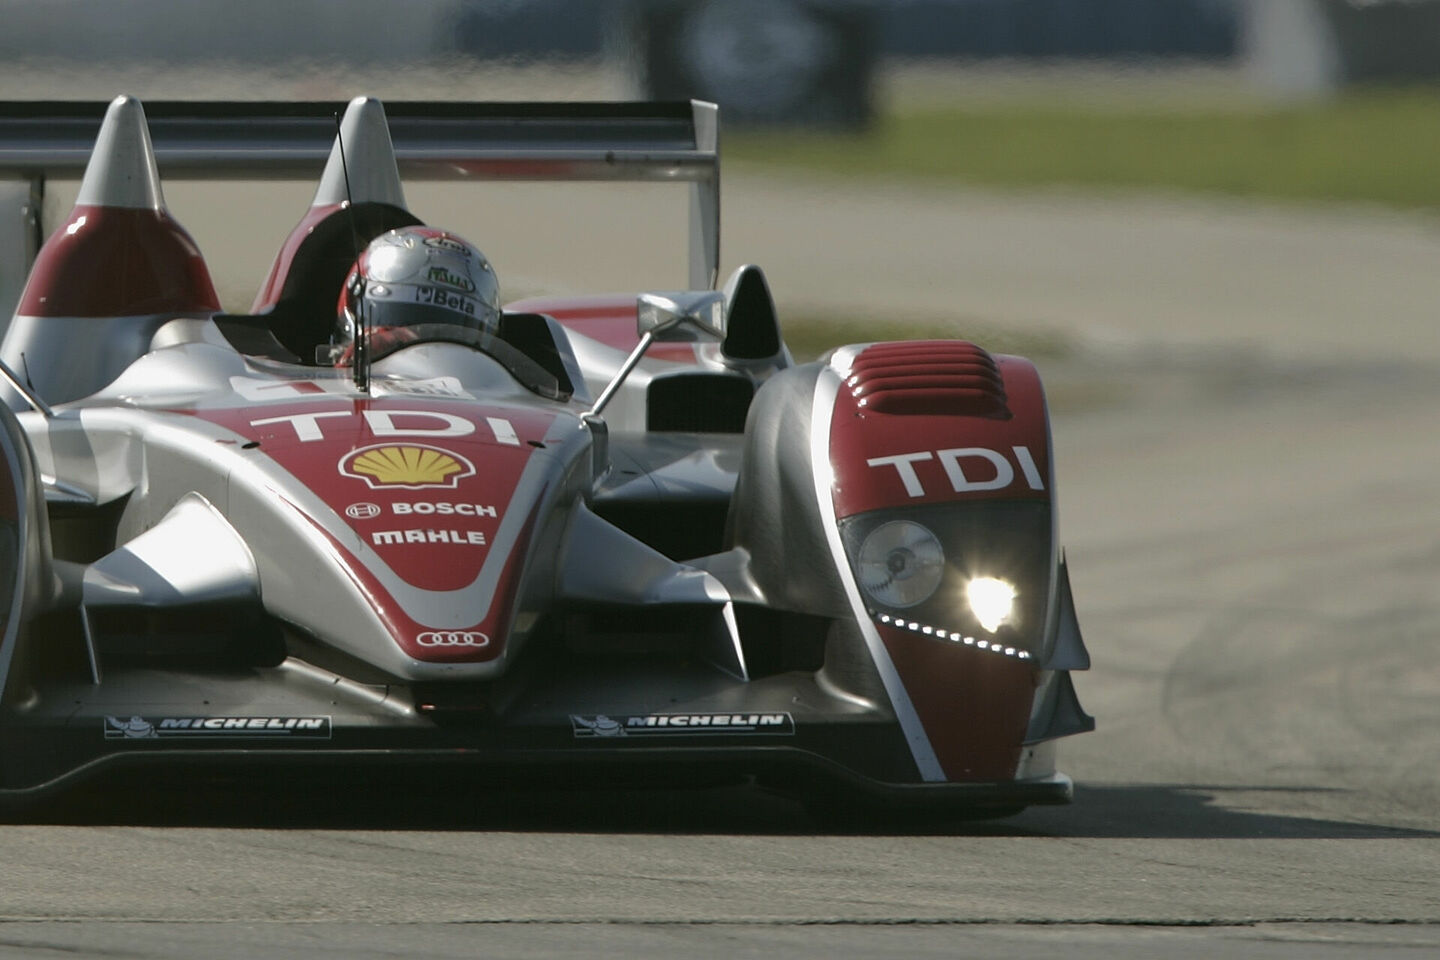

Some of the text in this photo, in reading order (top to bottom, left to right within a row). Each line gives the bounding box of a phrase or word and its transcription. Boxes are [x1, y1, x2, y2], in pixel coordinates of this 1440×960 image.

[434, 290, 475, 315] Beta
[250, 410, 521, 446] TDI
[867, 446, 1045, 497] TDI
[391, 502, 498, 518] BOSCH
[372, 529, 486, 545] MAHLE
[160, 718, 324, 729] MICHELIN
[627, 715, 785, 727] MICHELIN
